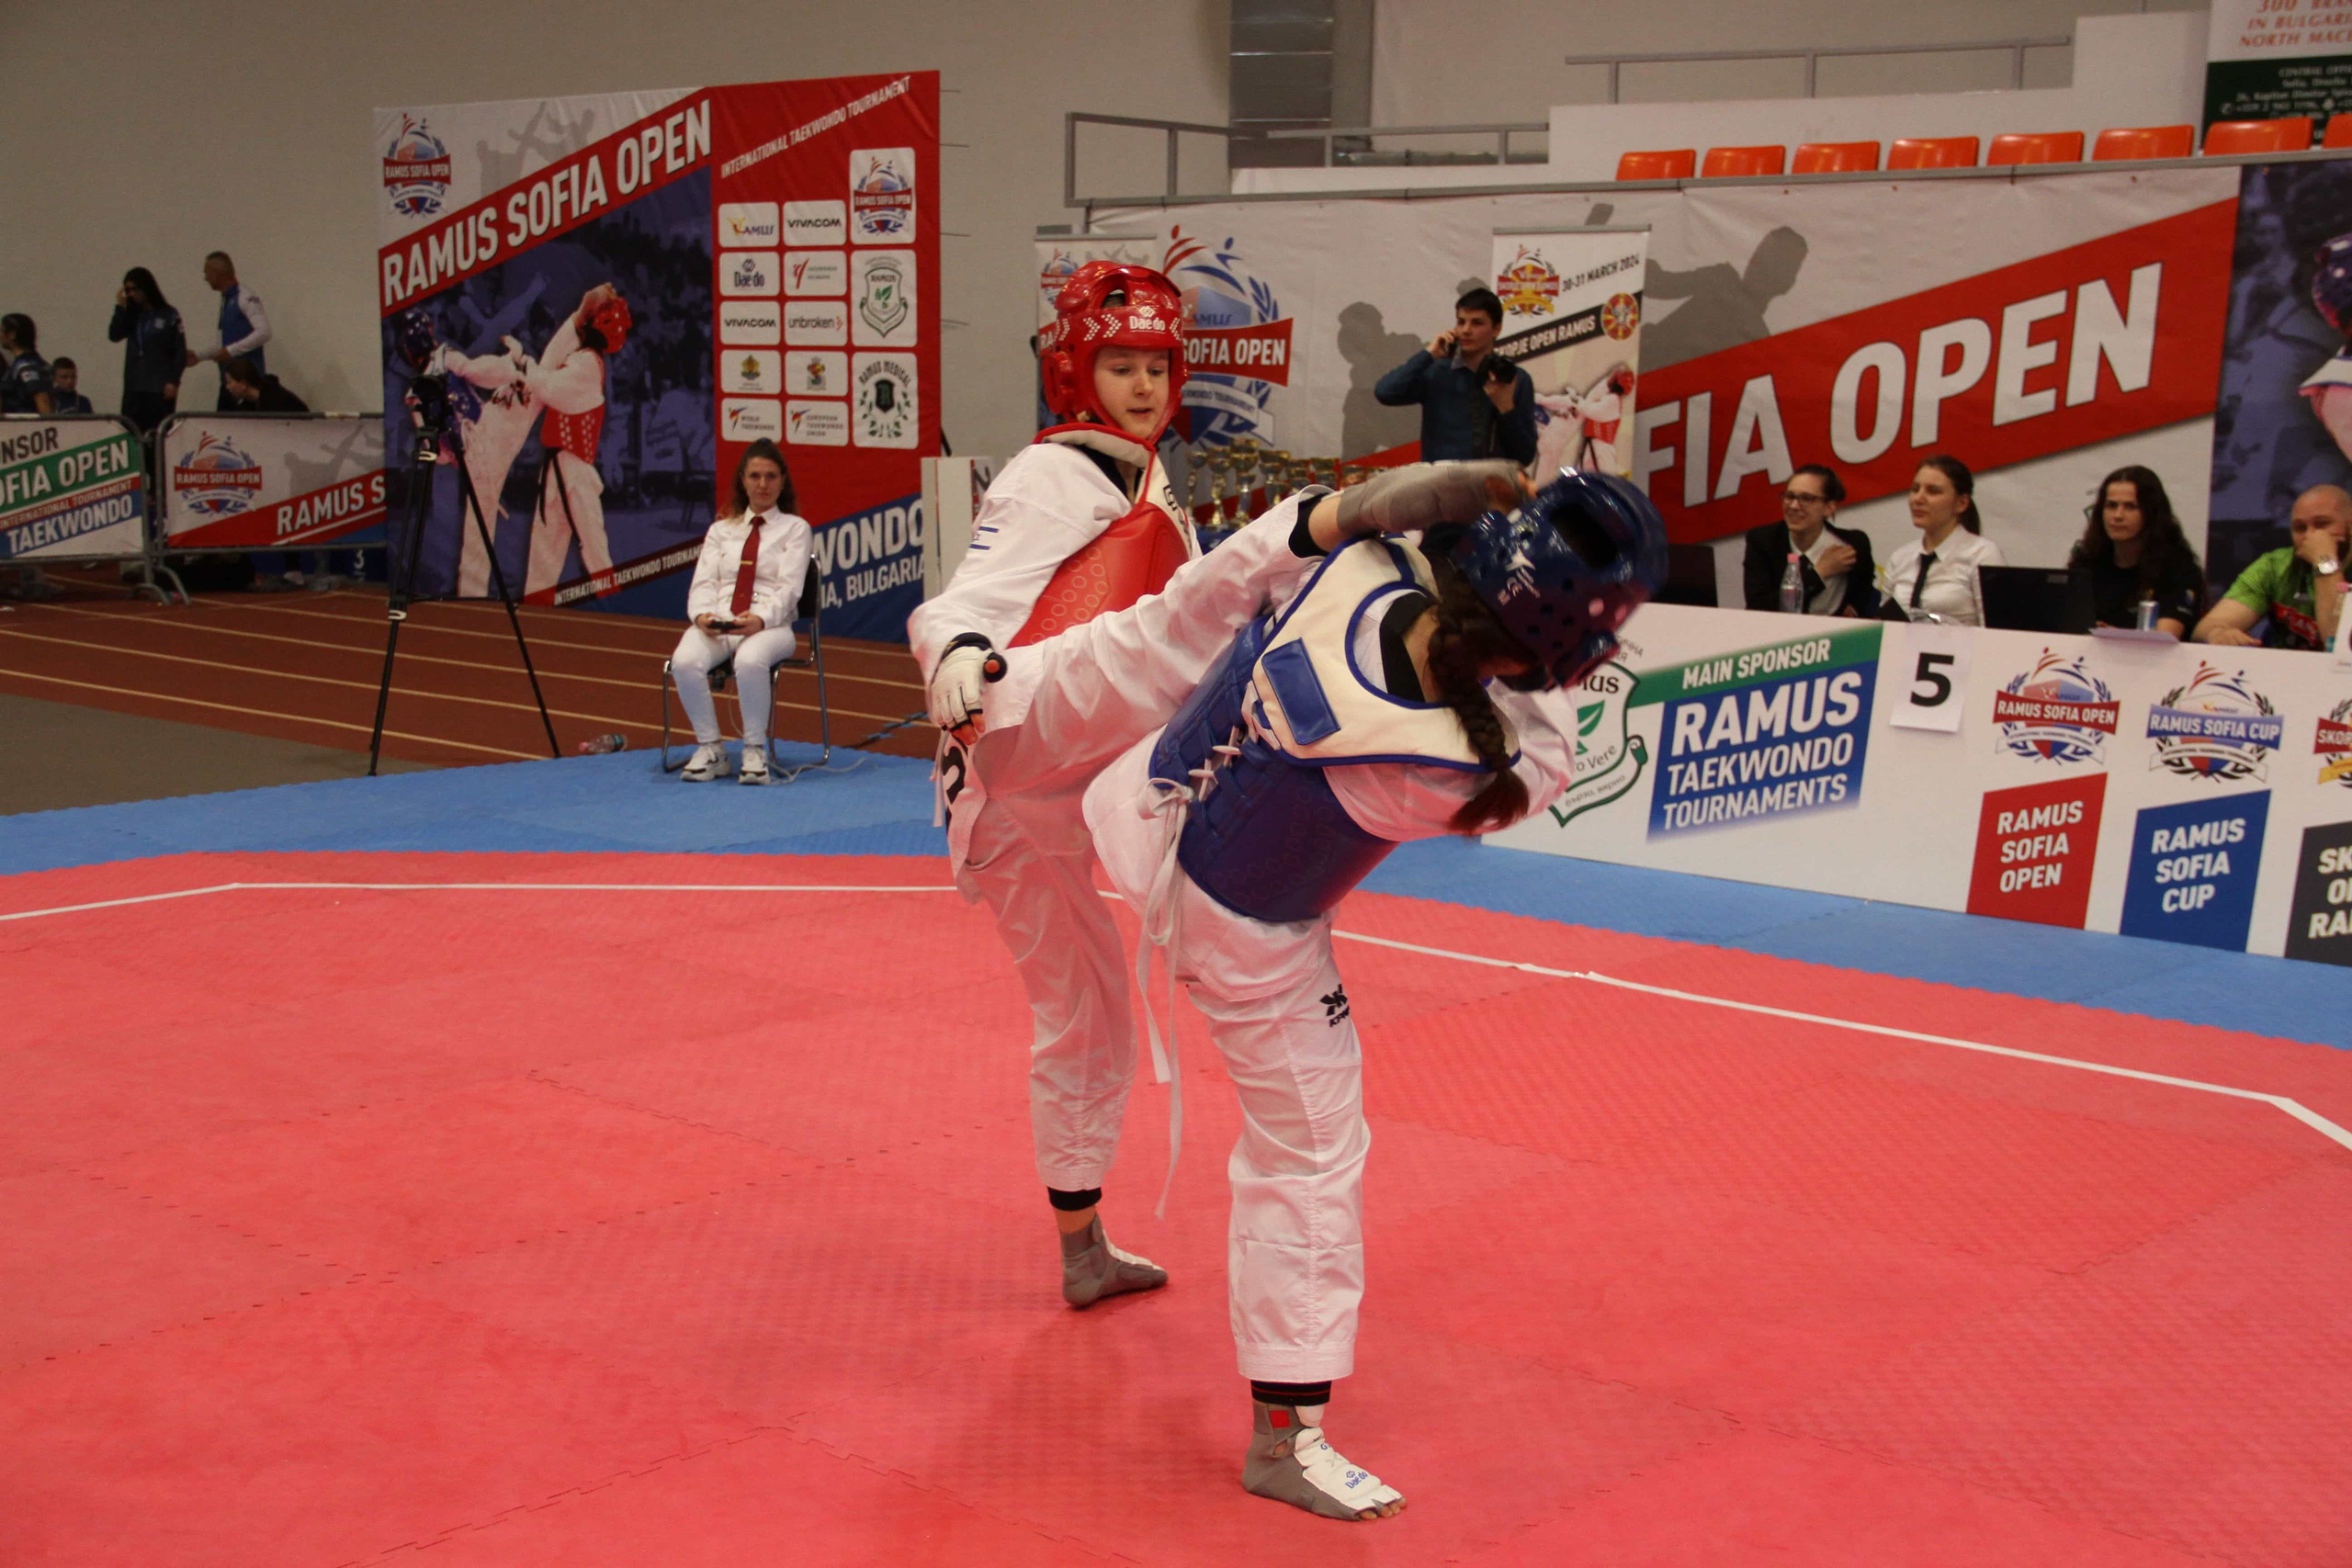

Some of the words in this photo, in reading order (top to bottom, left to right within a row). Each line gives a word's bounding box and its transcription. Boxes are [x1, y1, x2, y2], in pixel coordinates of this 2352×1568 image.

[2240, 33, 2301, 46] NORTH
[721, 135, 788, 178] INTERNATIONAL
[789, 107, 846, 145] TAEKWONDO
[847, 75, 910, 118] TOURNAMENT
[384, 165, 409, 178] RAMUS
[410, 165, 430, 177] SOFIA
[431, 163, 450, 176] OPEN
[384, 207, 498, 307] RAMUS
[507, 154, 607, 247] SOFIA
[616, 99, 711, 194] OPEN
[787, 219, 842, 228] VIVACOM
[1587, 261, 1619, 283] MARCH
[725, 319, 776, 327] VIVACOM
[788, 317, 834, 329] unbroken
[1530, 326, 1556, 352] OPEN
[1558, 315, 1596, 342] RAMUS
[1235, 338, 1285, 366] OPEN
[1633, 374, 1793, 507] FIA
[1830, 263, 2162, 465] OPEN
[58, 440, 130, 487] OPEN
[176, 472, 208, 483] RAMUS
[209, 472, 235, 483] SOFIA
[237, 472, 260, 483] OPEN
[73, 480, 132, 506] TOURNAMENT
[277, 482, 365, 536] RAMUS
[6, 494, 133, 553] TAEKWONDO
[554, 576, 612, 605] INTERNATIONAL
[613, 558, 662, 584] TAEKWONDO
[662, 543, 704, 570] TOURNAM
[1682, 659, 1734, 690] MAIN
[1736, 637, 1830, 680] SPONSOR
[1909, 651, 1955, 708] 5
[1670, 671, 1861, 757] RAMUS
[1997, 700, 2041, 717] RAMUS
[2043, 705, 2079, 721] SOFIA
[2082, 708, 2115, 725] OPEN
[2150, 714, 2201, 733] RAMUS
[2203, 719, 2246, 738] SOFIA
[2249, 723, 2280, 740] CUP
[1667, 732, 1854, 796] TAEKWONDO
[1663, 773, 1849, 830] TOURNAMENTS
[1996, 800, 2084, 835] RAMUS
[2001, 832, 2069, 864] SOFIA
[2152, 818, 2245, 854] RAMUS
[1999, 863, 2062, 894] OPEN
[2155, 851, 2231, 884] SOFIA
[2162, 883, 2215, 914] CUP
[2308, 911, 2352, 939] RA
